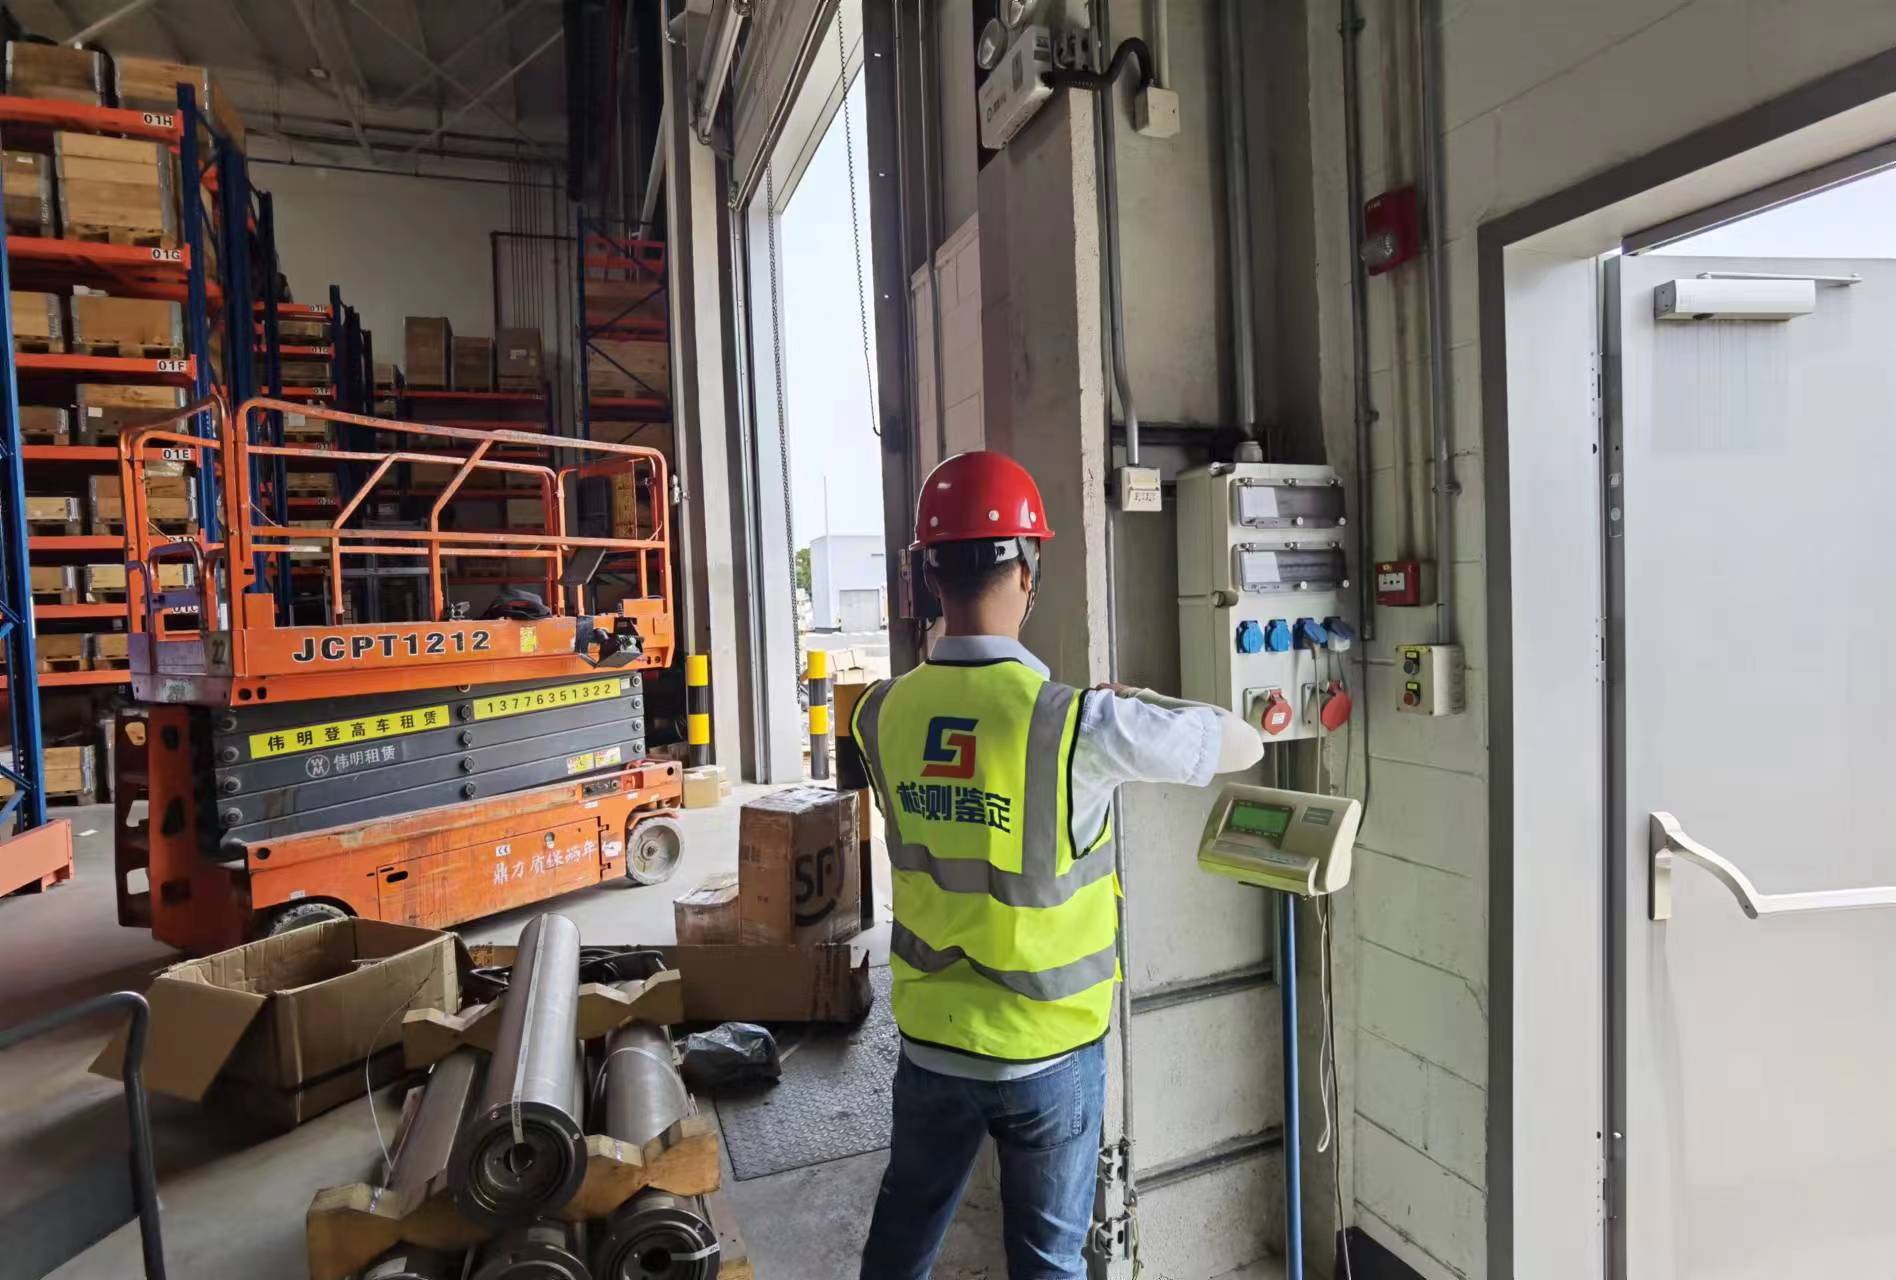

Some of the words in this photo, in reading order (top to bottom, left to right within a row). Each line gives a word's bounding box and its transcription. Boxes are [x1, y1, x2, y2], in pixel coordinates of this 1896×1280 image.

[144, 113, 172, 126] 01H
[153, 249, 181, 260] 01G
[159, 360, 185, 371] 01F
[163, 449, 189, 459] 01E
[292, 630, 490, 662] JCPT1212
[487, 682, 613, 713] 13776351322
[267, 709, 438, 752] 伟明登高车租赁
[333, 744, 396, 772] 伟明租赁
[896, 781, 1011, 834] 检测鉴定
